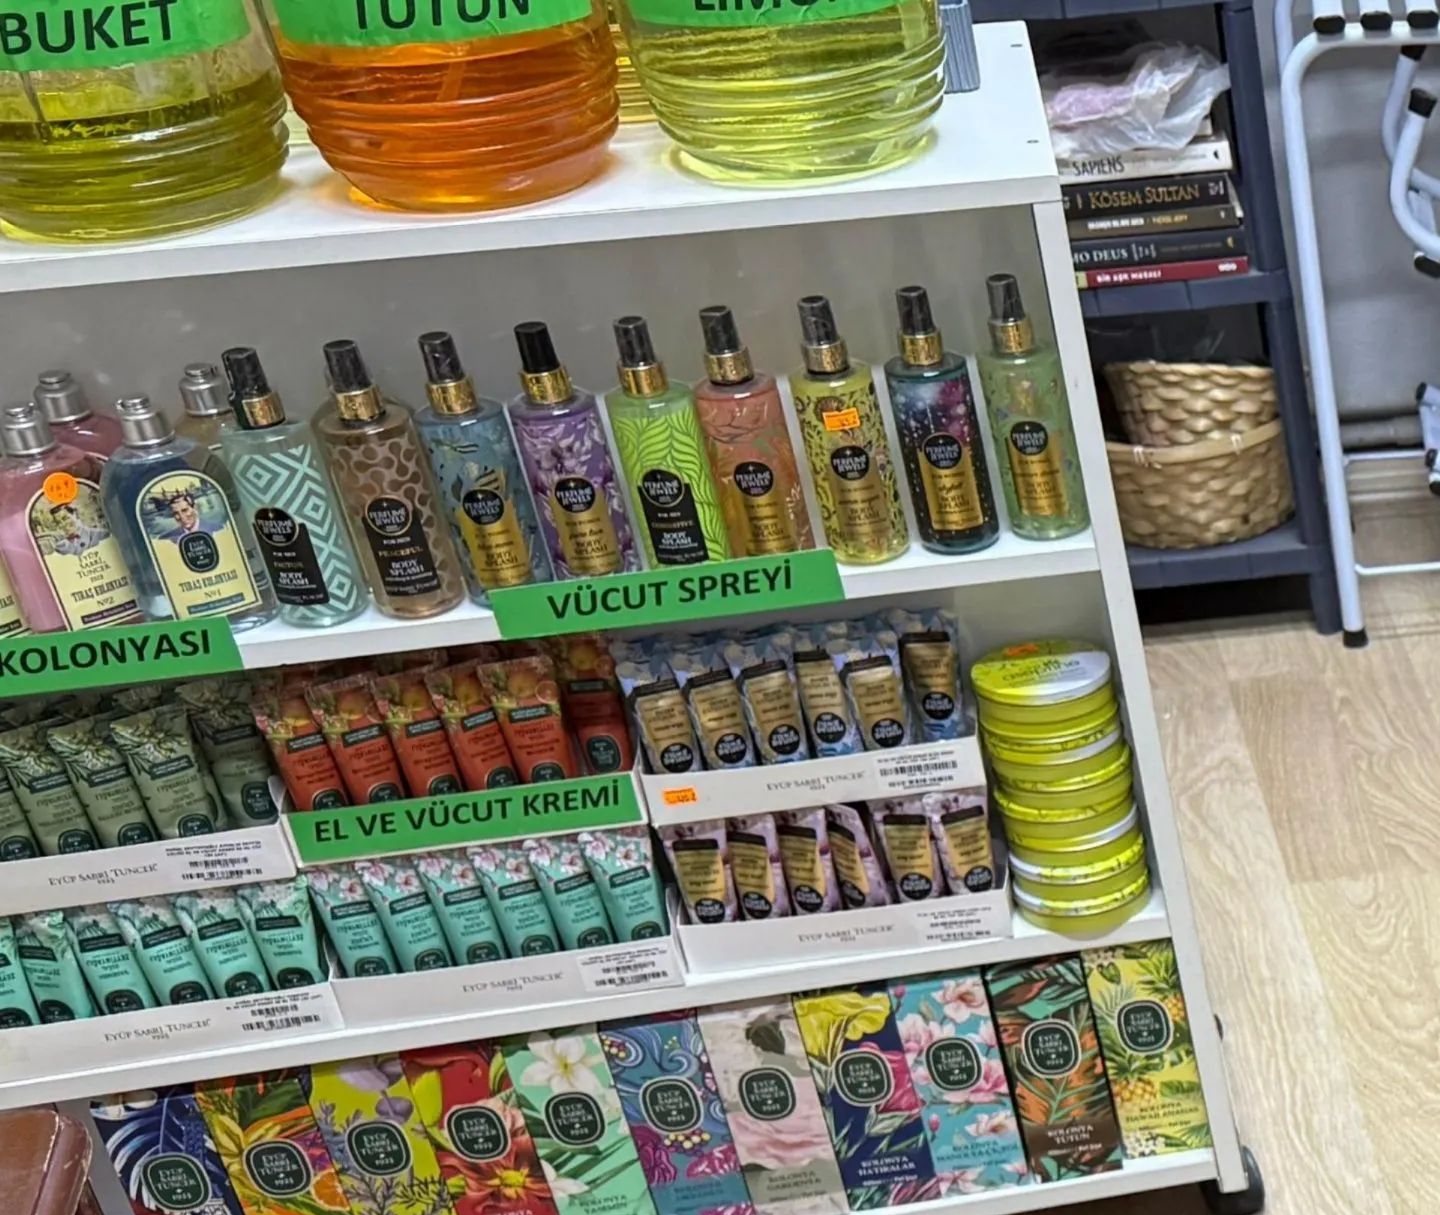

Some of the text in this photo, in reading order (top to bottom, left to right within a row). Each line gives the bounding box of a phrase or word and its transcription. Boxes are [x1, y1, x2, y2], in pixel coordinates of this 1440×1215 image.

[2, 0, 177, 55] BUKET
[1072, 156, 1124, 176] SAPIENS
[1144, 184, 1200, 205] SULTAN
[546, 558, 792, 620] VÜCUT SPREYİ
[0, 629, 210, 678] KOLONYASI
[315, 781, 620, 843] EL VE VÜCUT KREMİ
